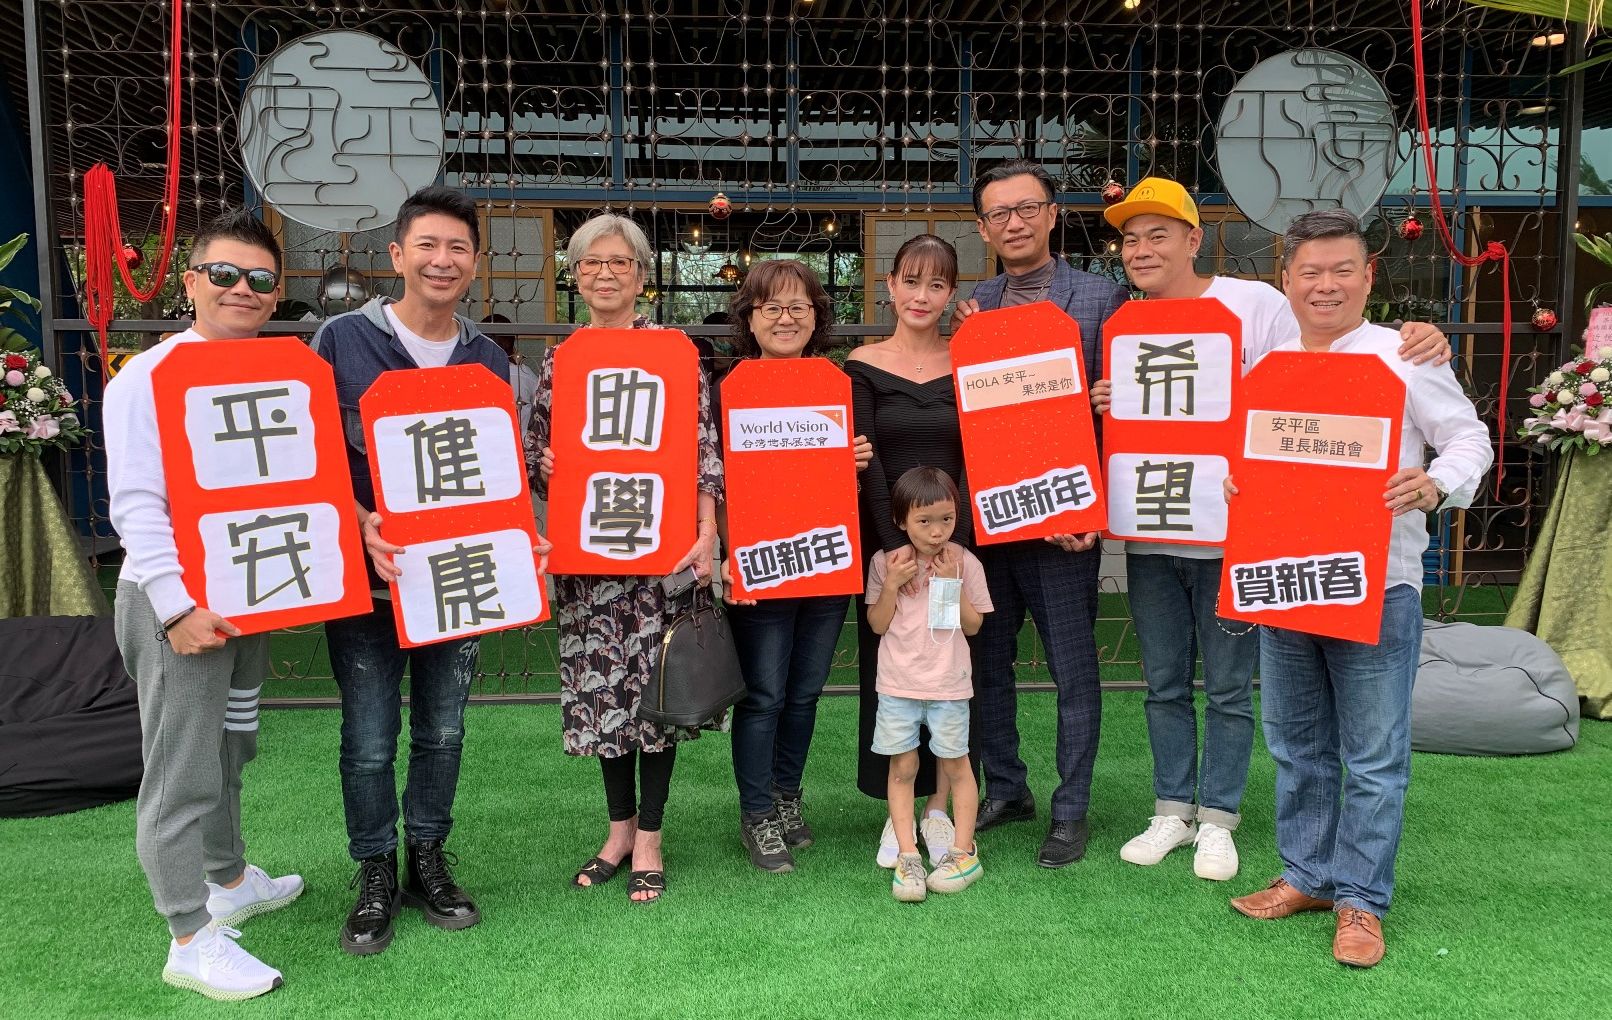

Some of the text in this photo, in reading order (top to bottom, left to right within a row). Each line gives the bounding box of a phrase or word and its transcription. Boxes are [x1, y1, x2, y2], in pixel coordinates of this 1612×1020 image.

[966, 377, 1000, 390] HOLA
[1022, 377, 1073, 396] 果然是你
[740, 420, 829, 434] World Vision
[1135, 339, 1199, 532] 希望
[1271, 417, 1321, 435] 安平區
[1279, 437, 1364, 457] 里長聯誼會
[588, 370, 659, 555] 助學
[212, 387, 312, 607] 平安
[981, 470, 1092, 530] 迎新年
[404, 416, 505, 633] 健康
[740, 530, 849, 587] 迎新年
[1234, 557, 1363, 607] 賀新春
